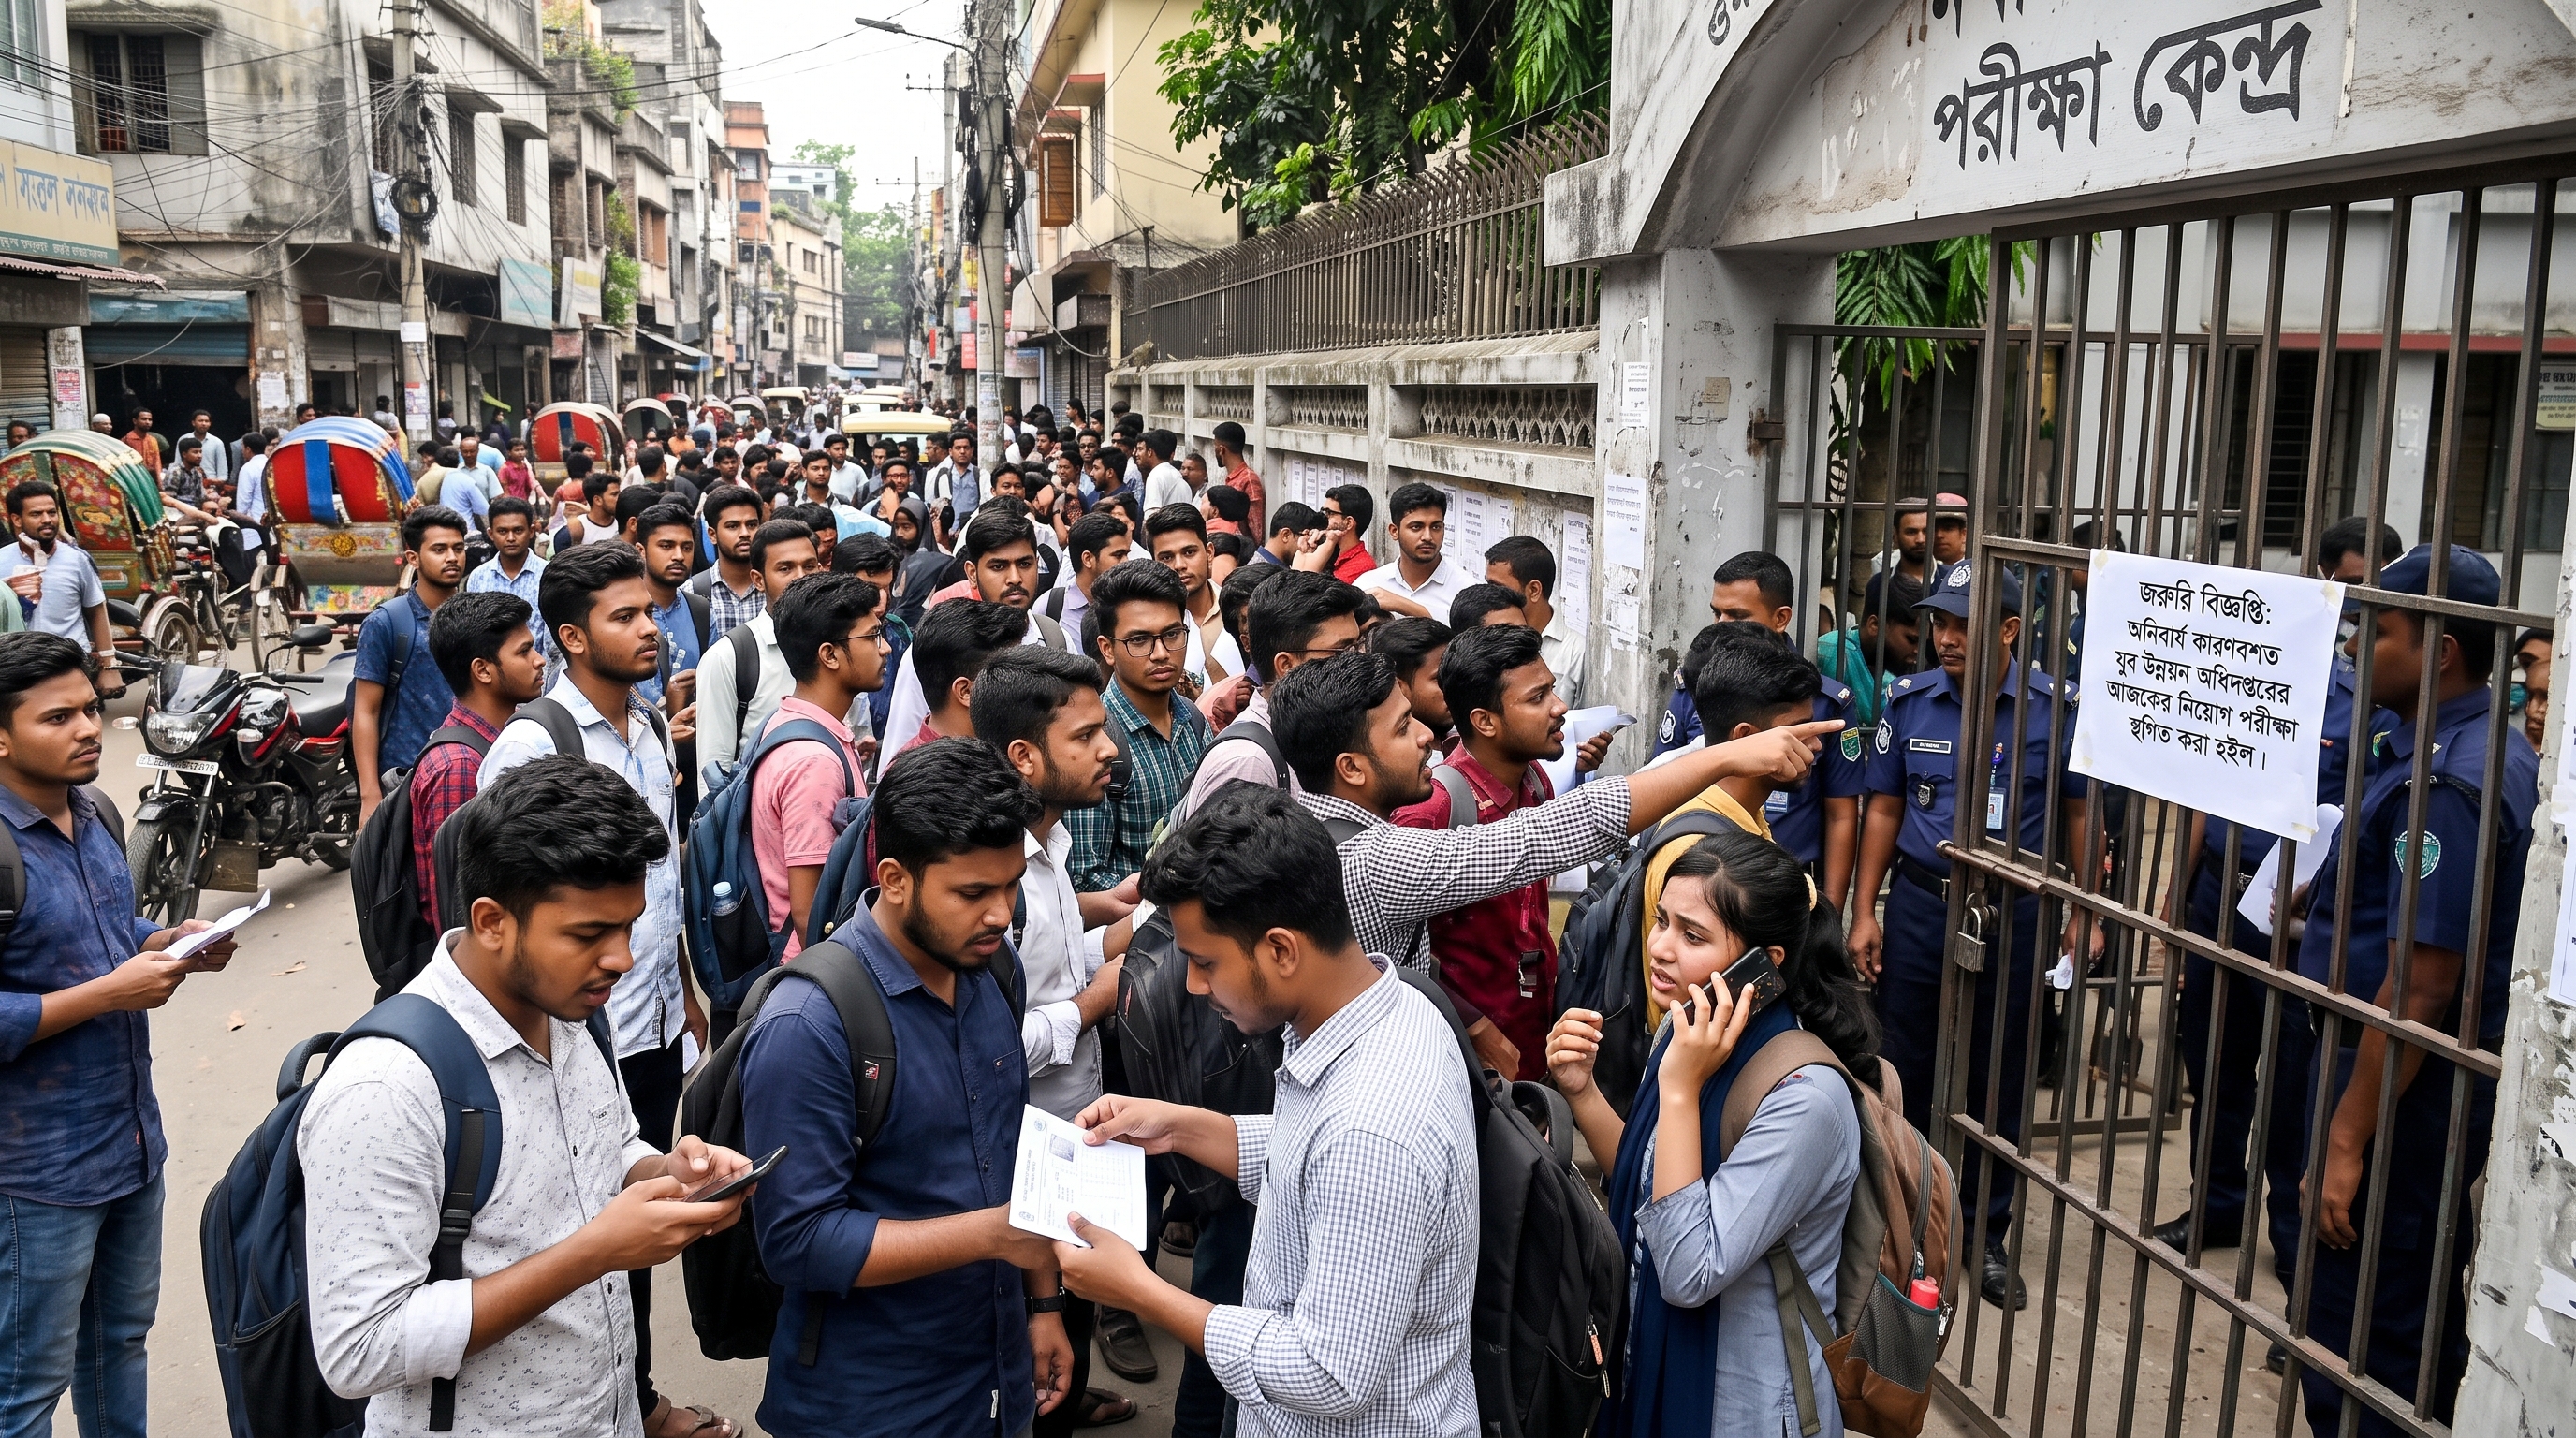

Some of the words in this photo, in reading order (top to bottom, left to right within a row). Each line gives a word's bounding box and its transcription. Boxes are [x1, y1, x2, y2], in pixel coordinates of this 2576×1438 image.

[1934, 40, 2113, 171] পরীক্ষা
[2133, 0, 2324, 132] কেন্দ্র
[2139, 579, 2196, 612] জরুরি
[2200, 582, 2272, 624] বিজ্ঞপ্তি:
[2127, 616, 2188, 651] অনিবার্য
[2191, 632, 2283, 666] কারণবশত
[2115, 650, 2139, 678] যুব
[2141, 649, 2193, 684] উন্নয়ন
[2196, 663, 2293, 706] অধিদপ্তরের
[2106, 680, 2174, 713] আজকের
[2176, 690, 2234, 728] নিয়োগ
[2239, 704, 2300, 743] পরীক্ষা
[2129, 713, 2174, 744] স্থগিত
[2175, 728, 2211, 756] করা
[2214, 733, 2256, 768] হইল
